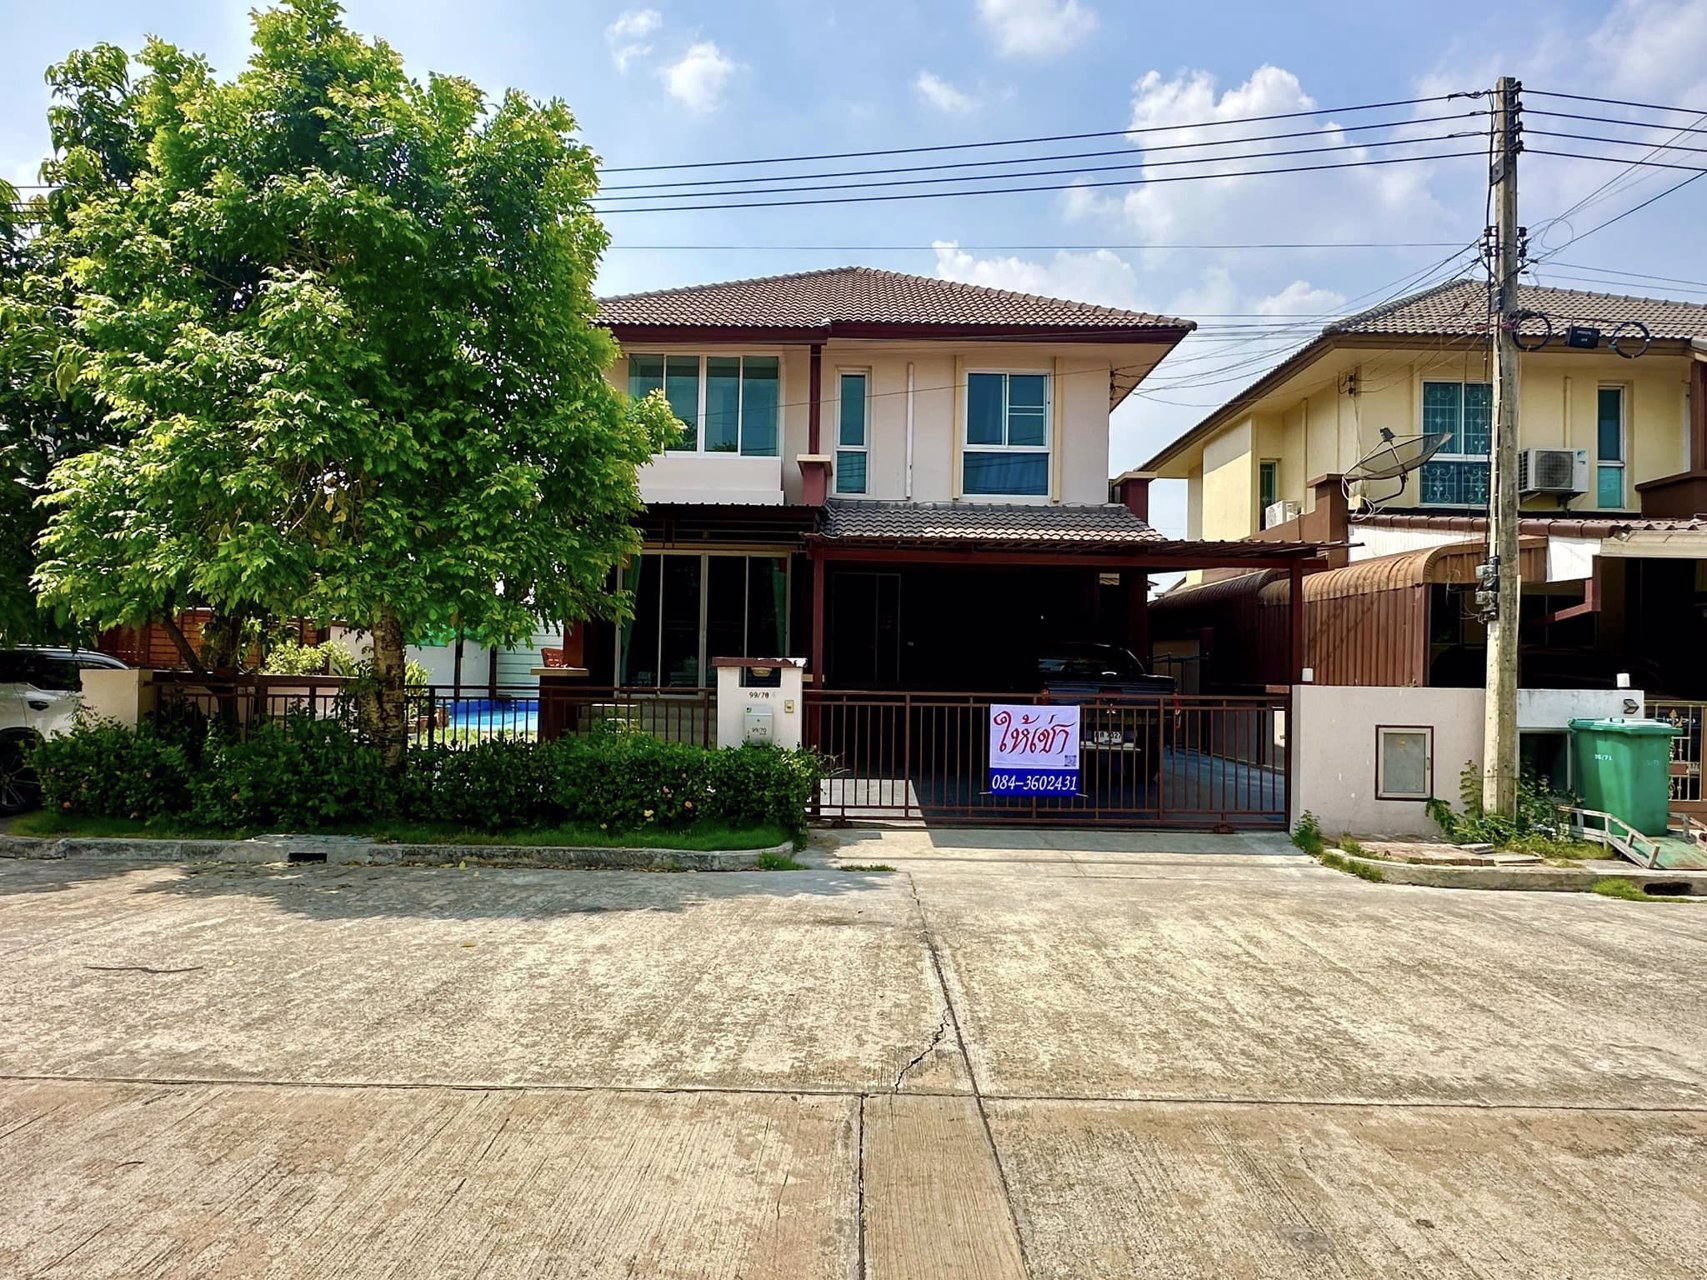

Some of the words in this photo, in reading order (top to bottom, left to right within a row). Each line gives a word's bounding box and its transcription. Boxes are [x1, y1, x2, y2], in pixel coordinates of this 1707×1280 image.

[993, 710, 1076, 754] ให้เช่า
[992, 774, 1077, 790] 084-3602431
